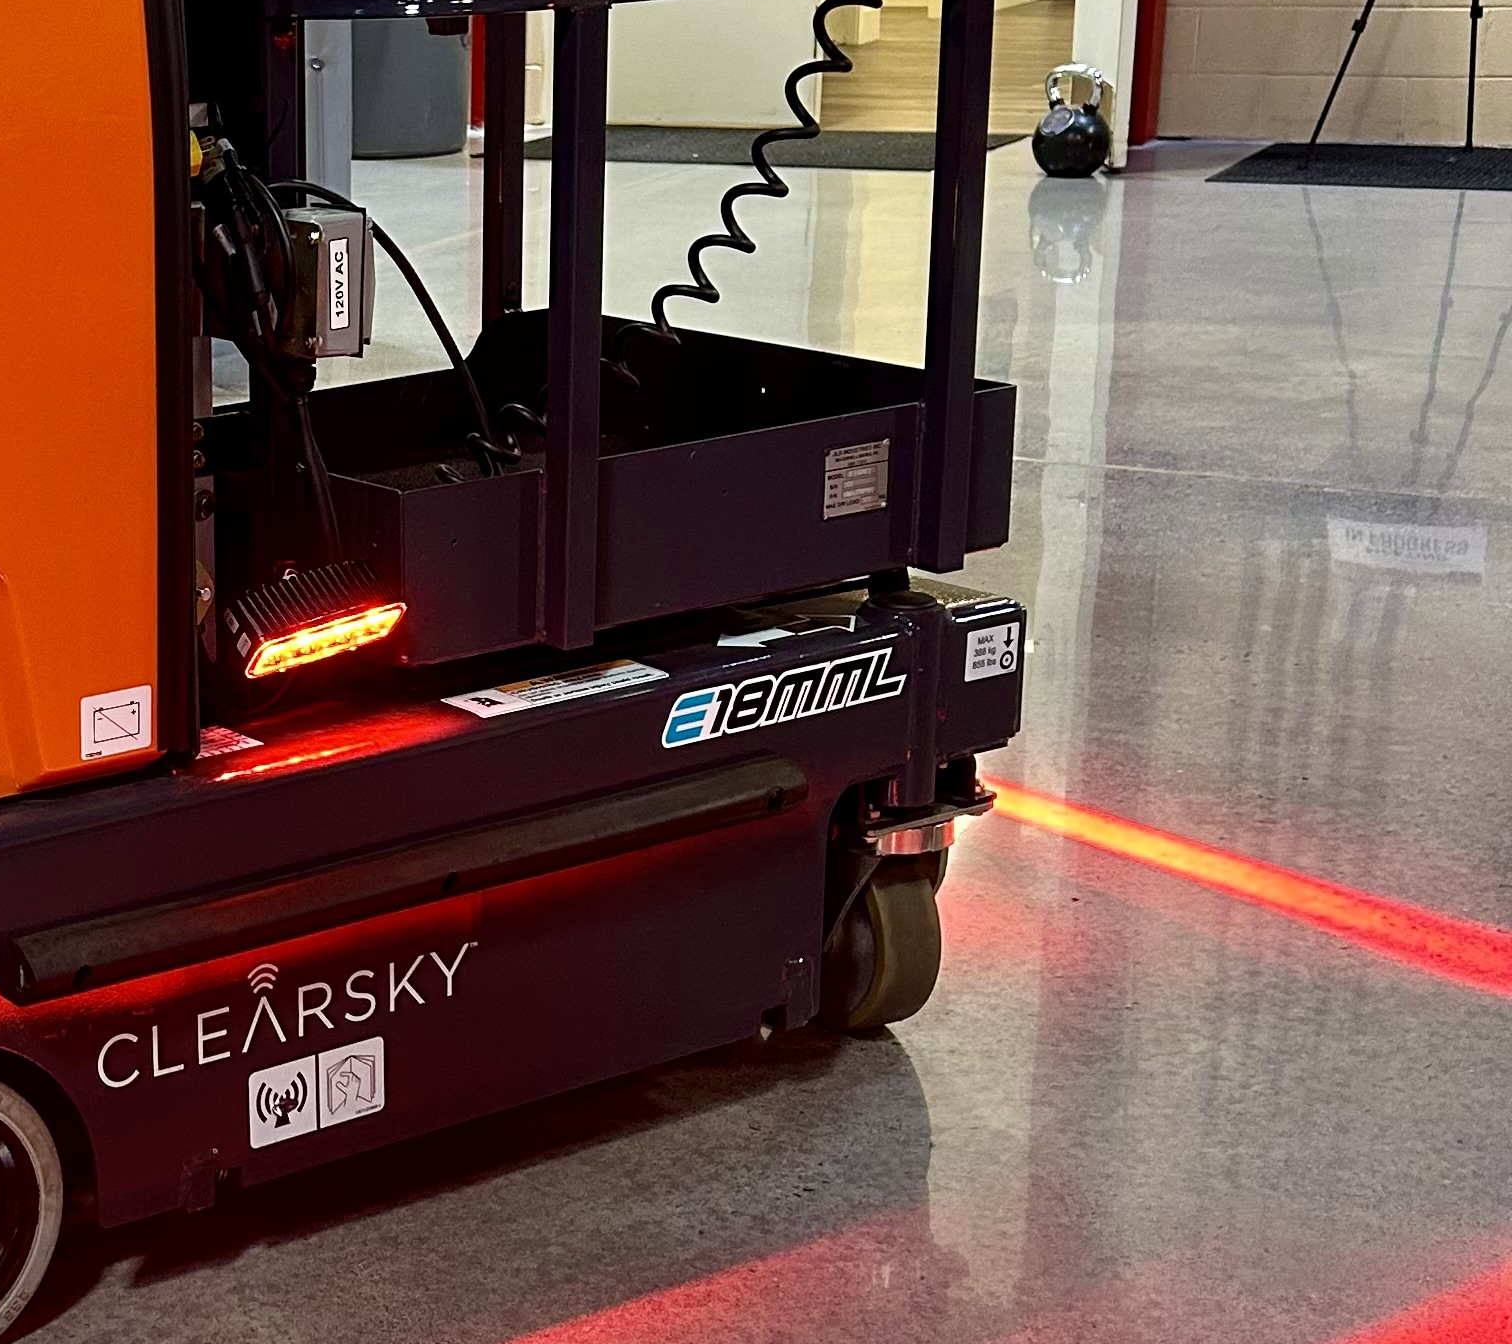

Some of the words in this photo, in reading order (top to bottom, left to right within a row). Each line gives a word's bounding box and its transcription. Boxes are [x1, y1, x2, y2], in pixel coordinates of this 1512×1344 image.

[334, 251, 344, 275] AC
[334, 279, 345, 317] 120V
[977, 634, 995, 645] MAX
[661, 647, 908, 749] E18MML
